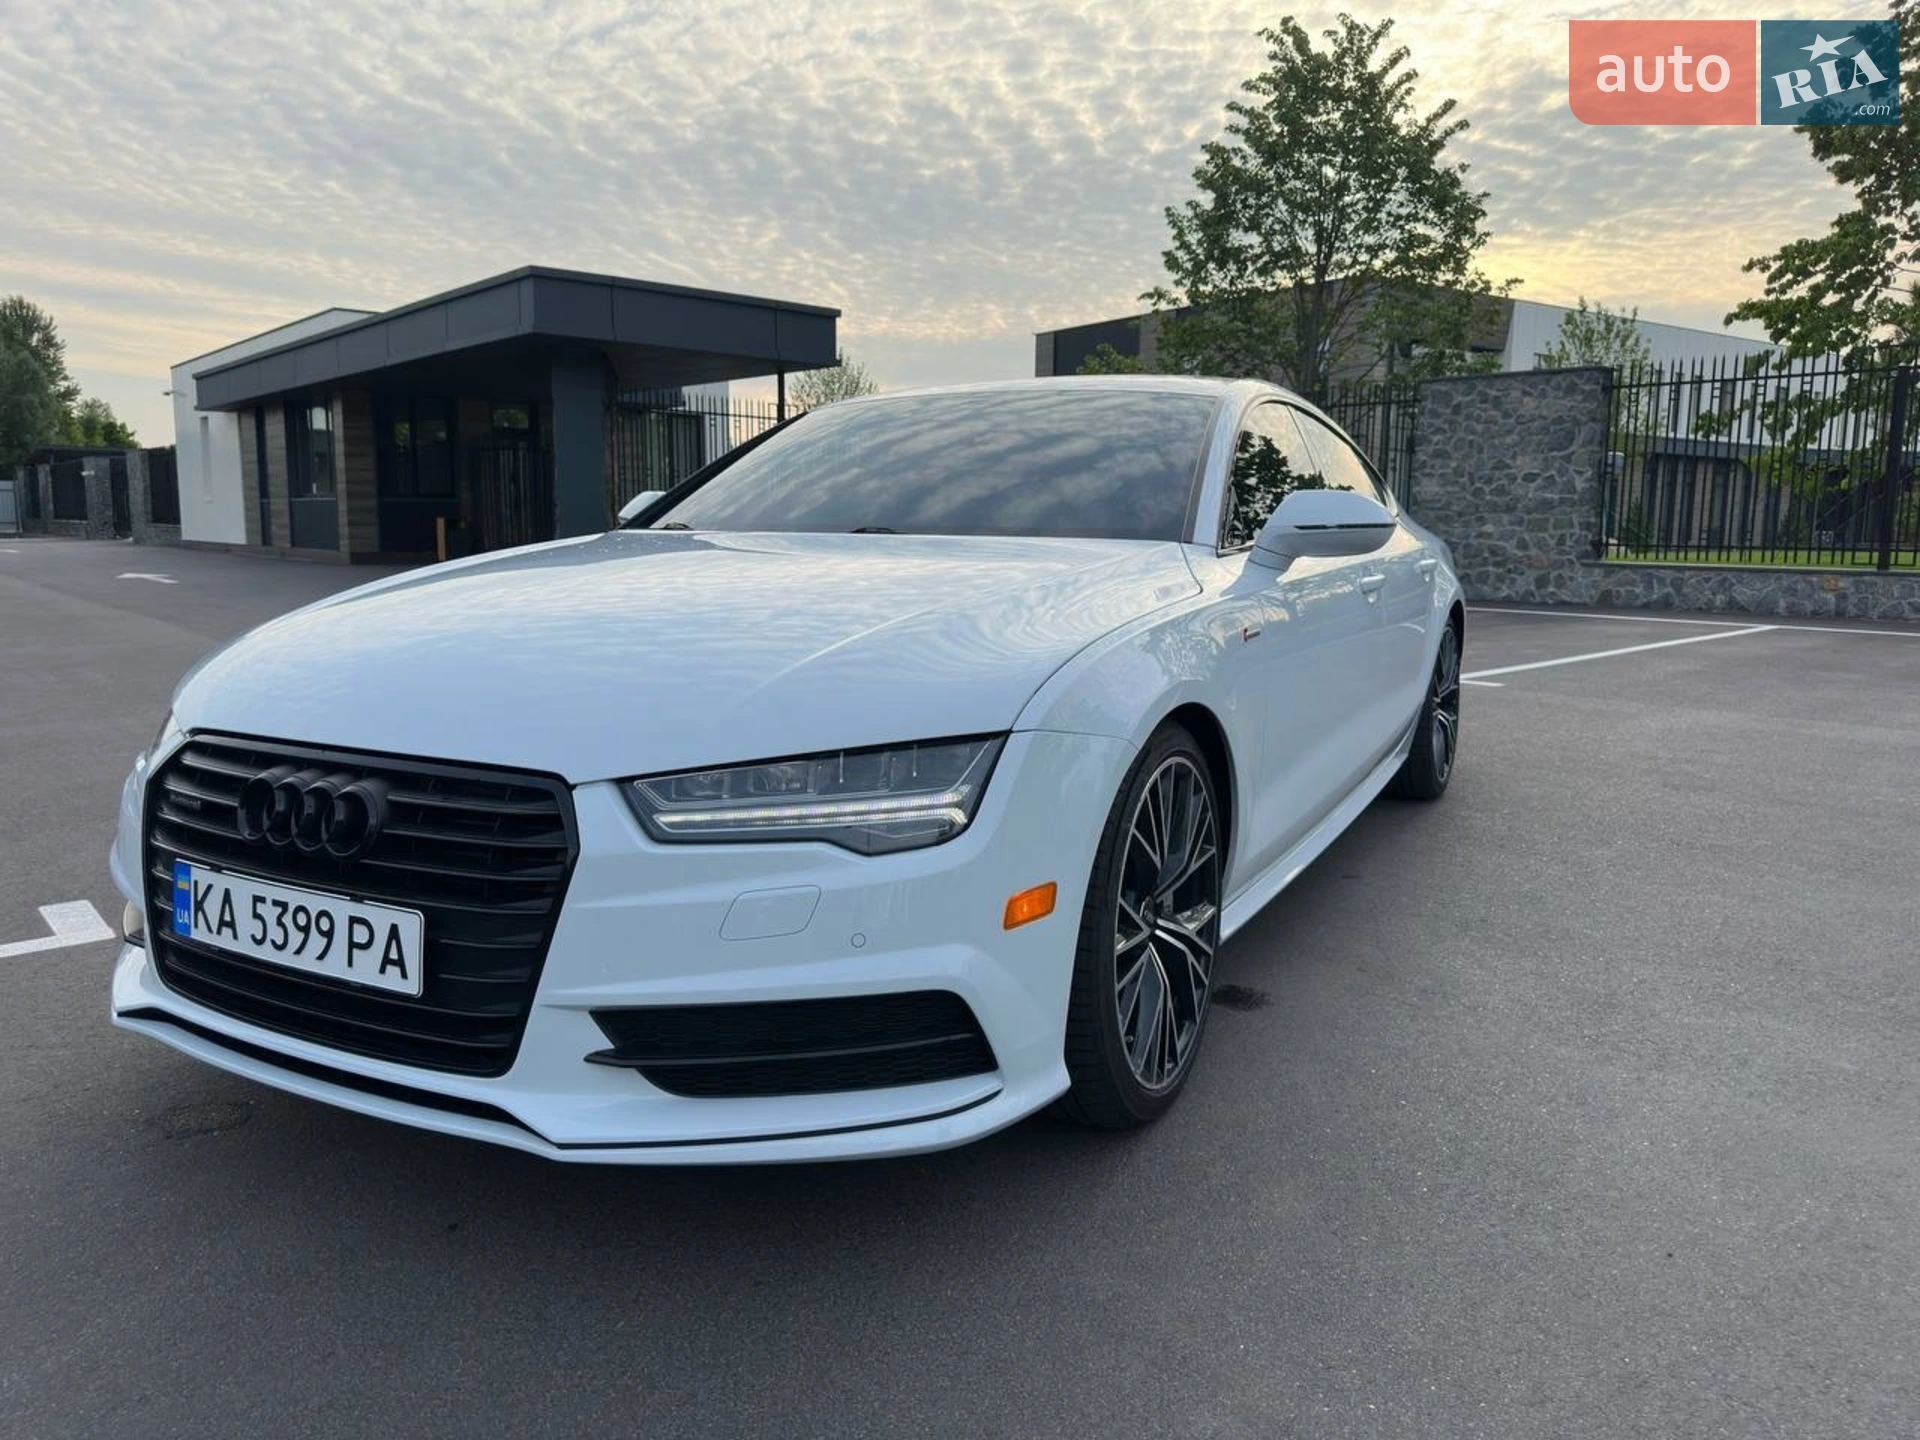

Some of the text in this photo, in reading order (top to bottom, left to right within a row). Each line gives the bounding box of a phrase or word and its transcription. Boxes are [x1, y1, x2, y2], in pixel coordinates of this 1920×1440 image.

[176, 908, 190, 925] UA
[193, 879, 408, 980] KA 5399 PA
